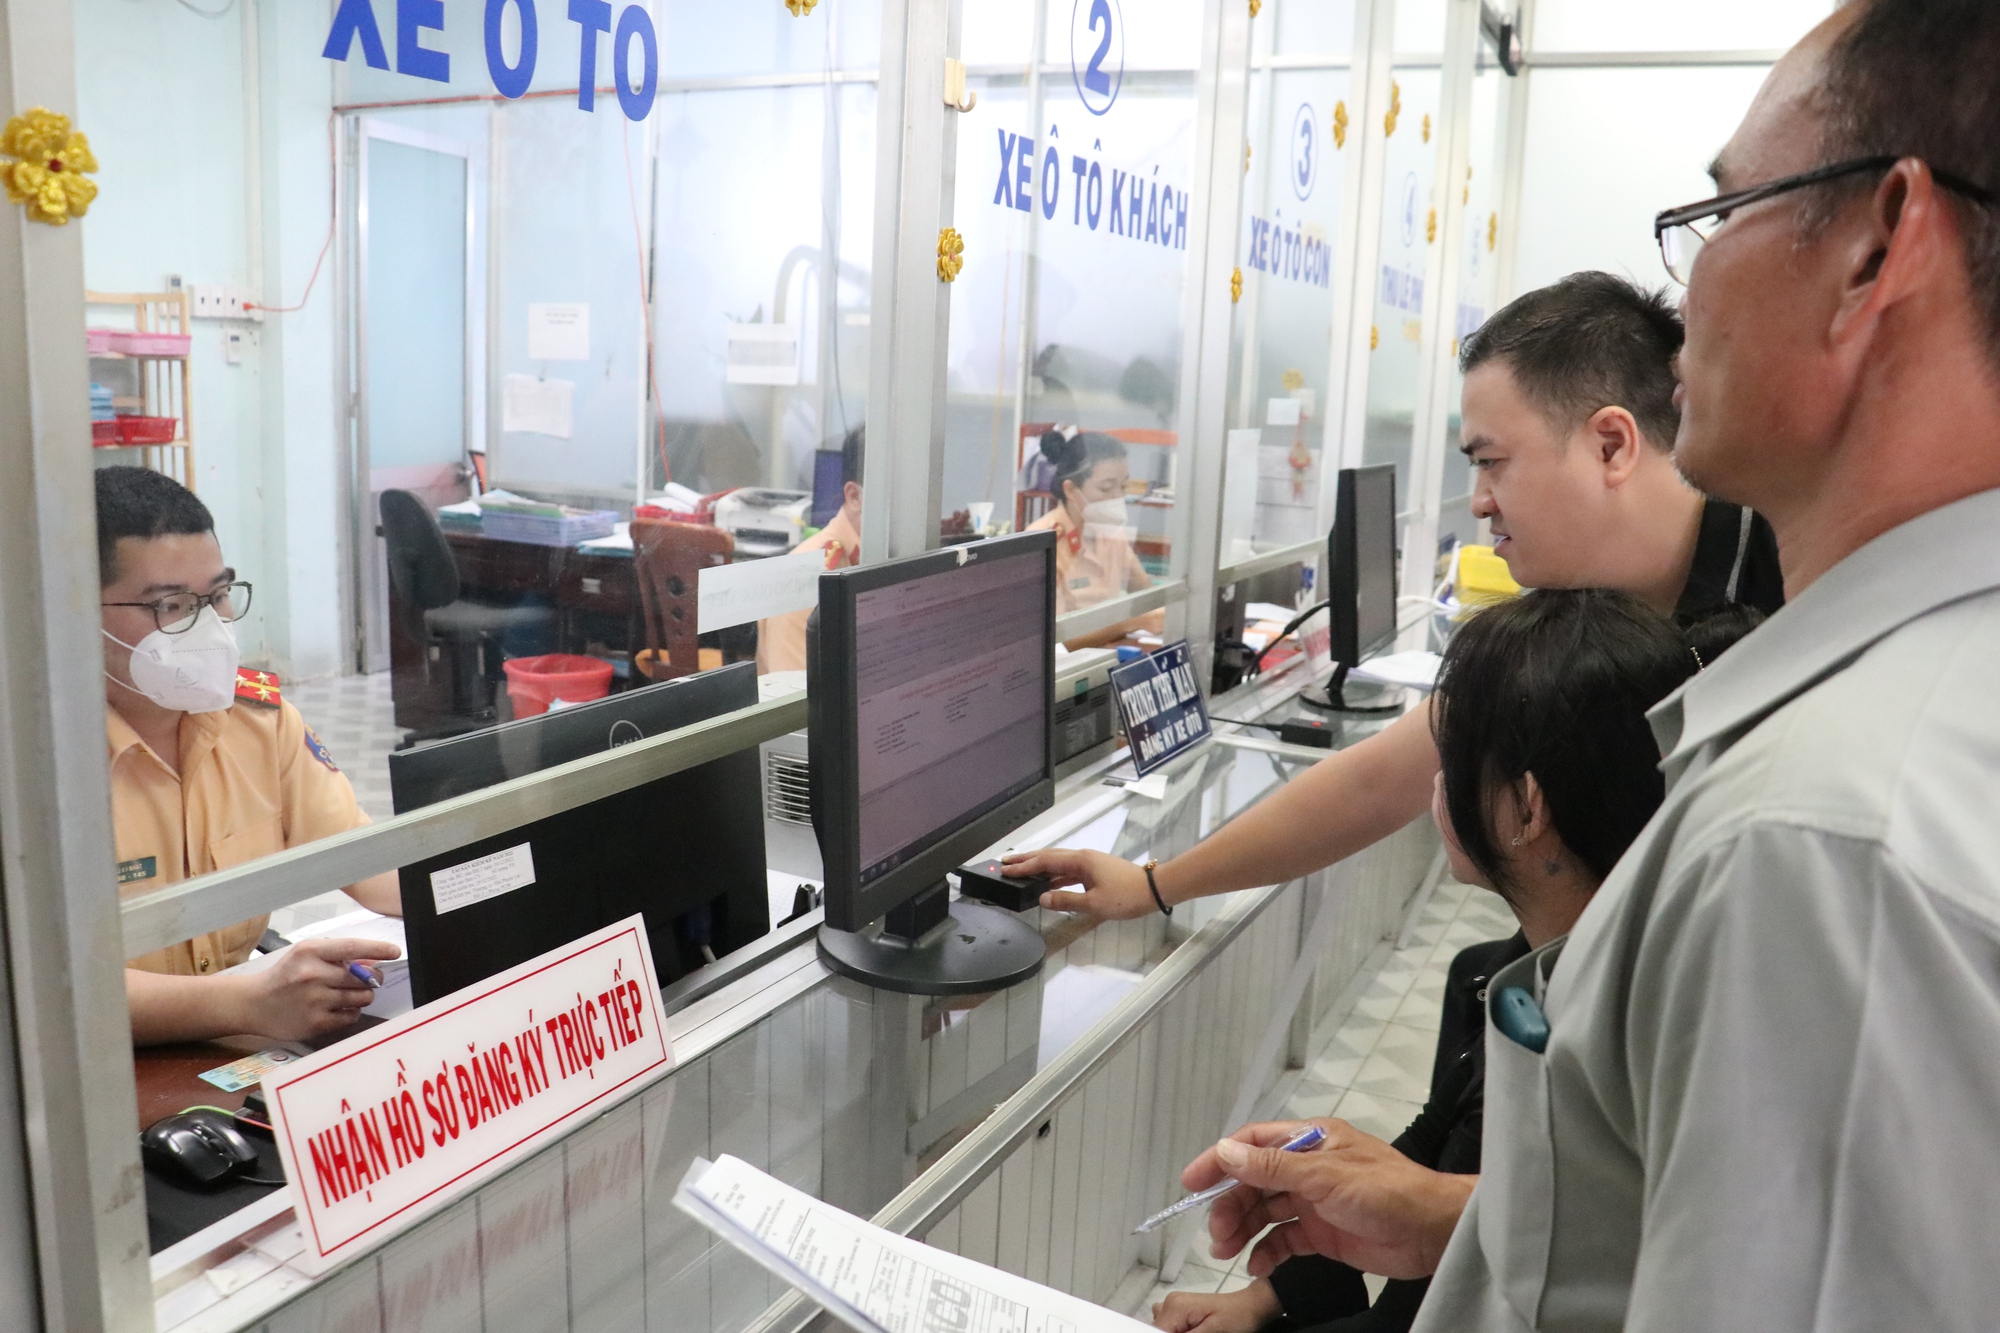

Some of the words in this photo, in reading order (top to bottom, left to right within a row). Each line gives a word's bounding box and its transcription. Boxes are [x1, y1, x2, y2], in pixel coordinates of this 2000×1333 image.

[1084, 0, 1113, 97] 2
[993, 127, 1035, 213] XE
[1041, 123, 1060, 221] Ô
[1071, 137, 1103, 231] TÔ
[1109, 164, 1189, 251] KHÁCH
[1297, 119, 1312, 187] 3
[1248, 215, 1269, 272] XE
[1271, 208, 1281, 275] Ô
[1284, 219, 1302, 281] TÔ
[1303, 235, 1331, 289] CON
[1174, 720, 1188, 743] XE
[307, 1098, 391, 1209] NHẬN
[381, 1058, 426, 1169] HỒ
[422, 1060, 461, 1148] SƠ
[454, 1041, 525, 1130] ĐĂNG
[514, 1009, 552, 1097] KÝ
[545, 991, 607, 1080] TRỰC
[598, 957, 645, 1053] TIẾP
